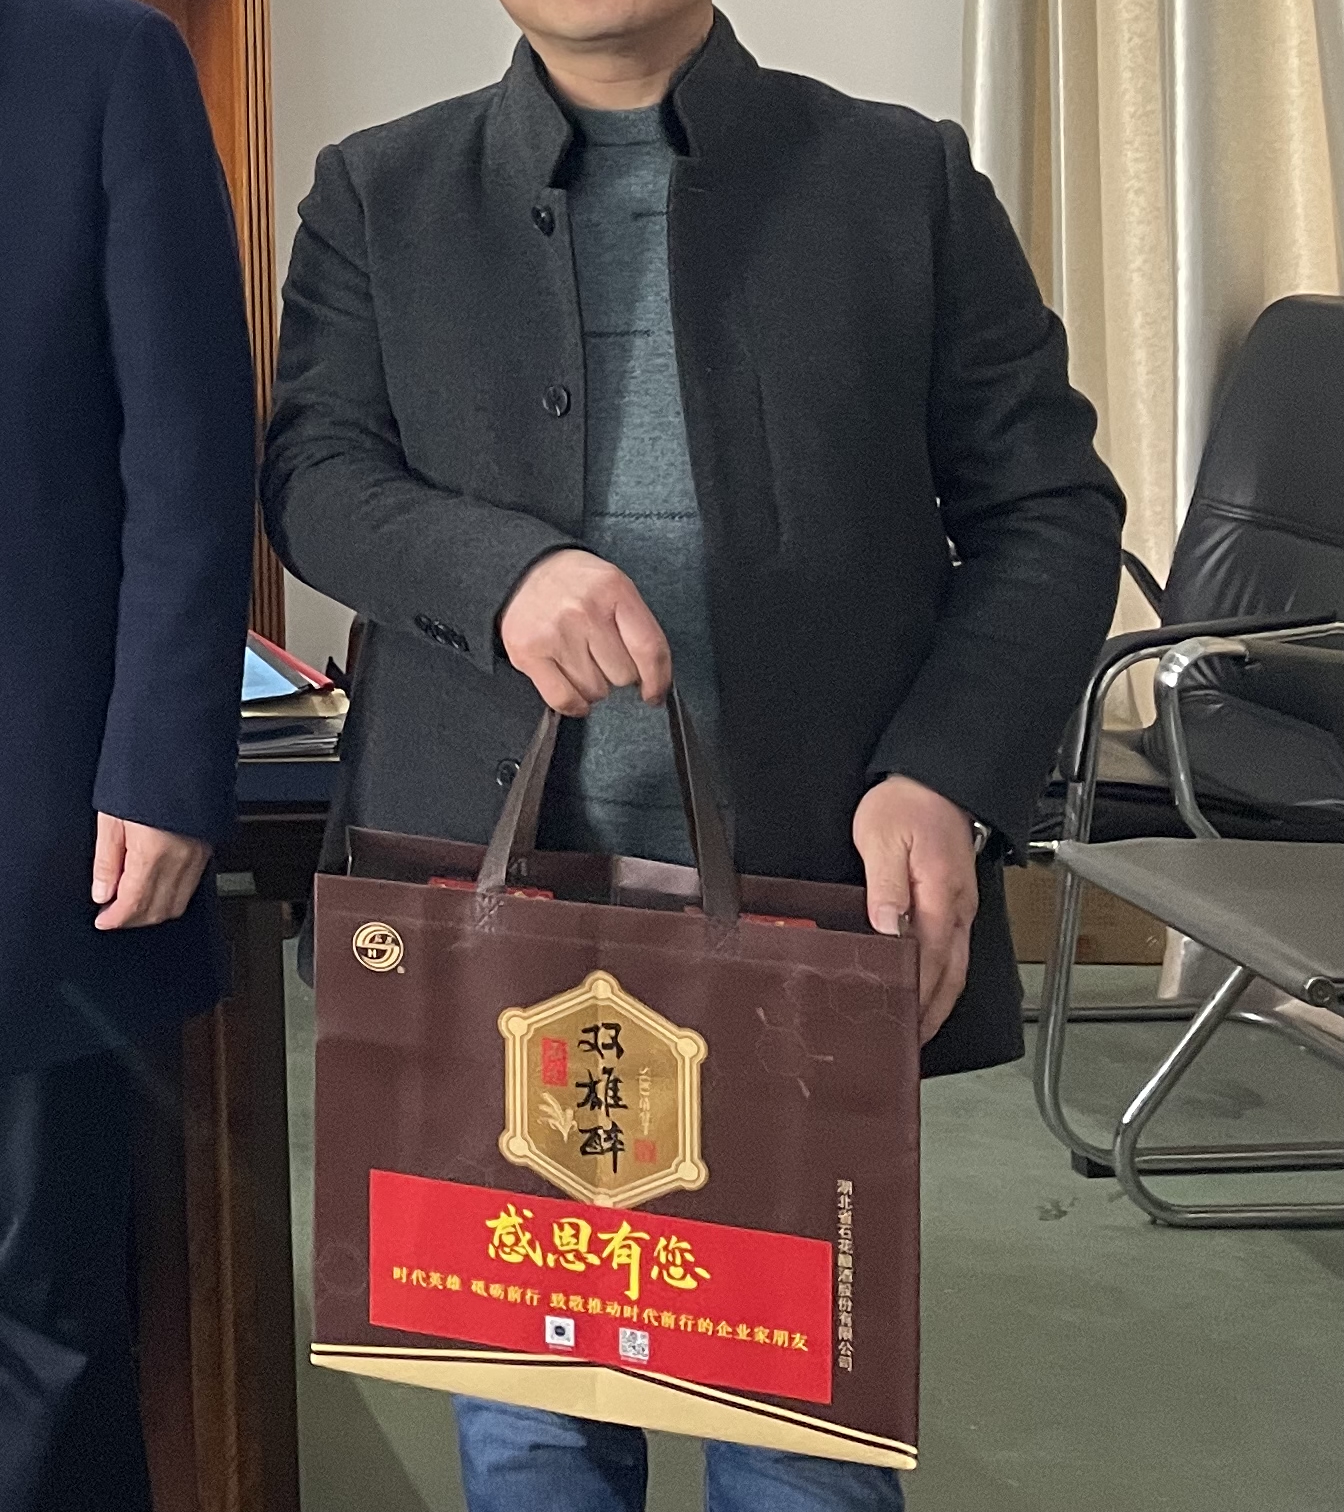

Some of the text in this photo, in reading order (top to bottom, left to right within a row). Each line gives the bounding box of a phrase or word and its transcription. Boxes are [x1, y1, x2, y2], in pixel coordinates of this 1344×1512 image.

[575, 1022, 629, 1175] 双雄醉
[392, 1266, 462, 1291] 时代英雄
[484, 1203, 712, 1301] 感恩有您
